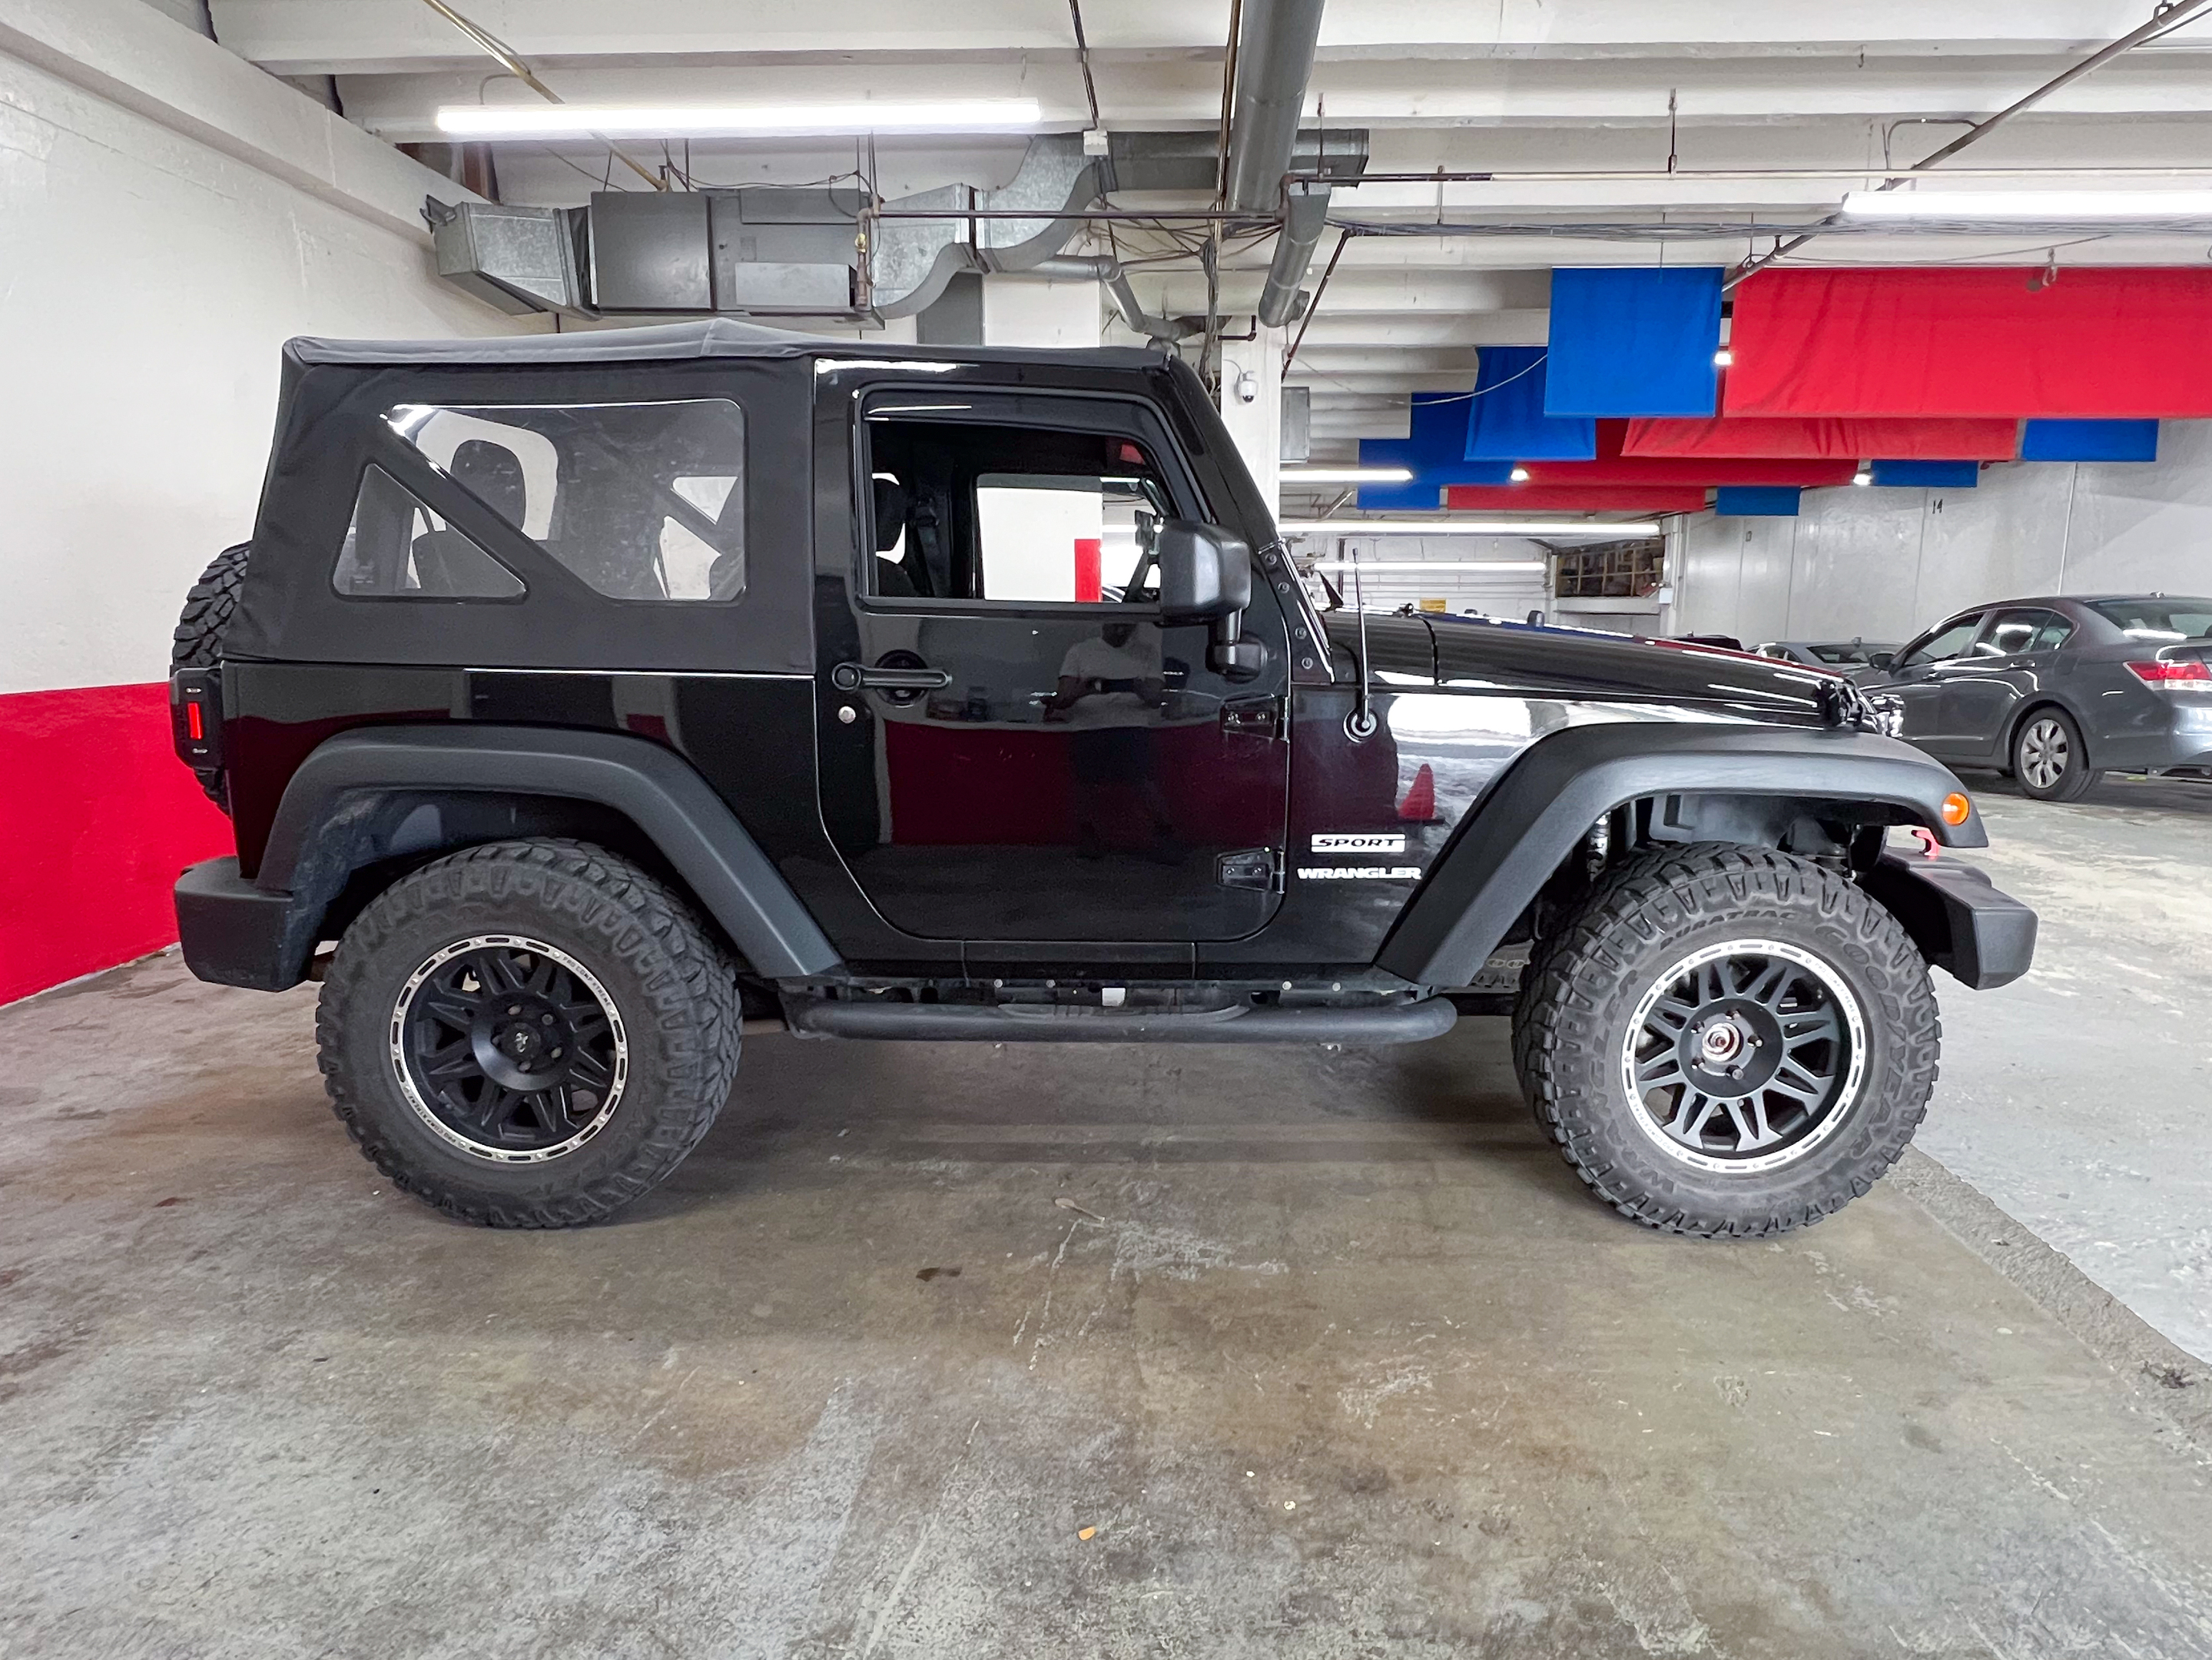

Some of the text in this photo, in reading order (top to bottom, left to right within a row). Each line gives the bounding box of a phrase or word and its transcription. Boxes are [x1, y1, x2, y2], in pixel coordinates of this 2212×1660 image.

[1932, 499, 1942, 514] 14
[1318, 838, 1400, 848] SPORT
[1297, 867, 1422, 880] WRANGLER
[1660, 910, 1795, 951] DURATRAC
[1814, 925, 1907, 1157] GOODYEAR
[1590, 969, 1675, 1194] WRANGLER
